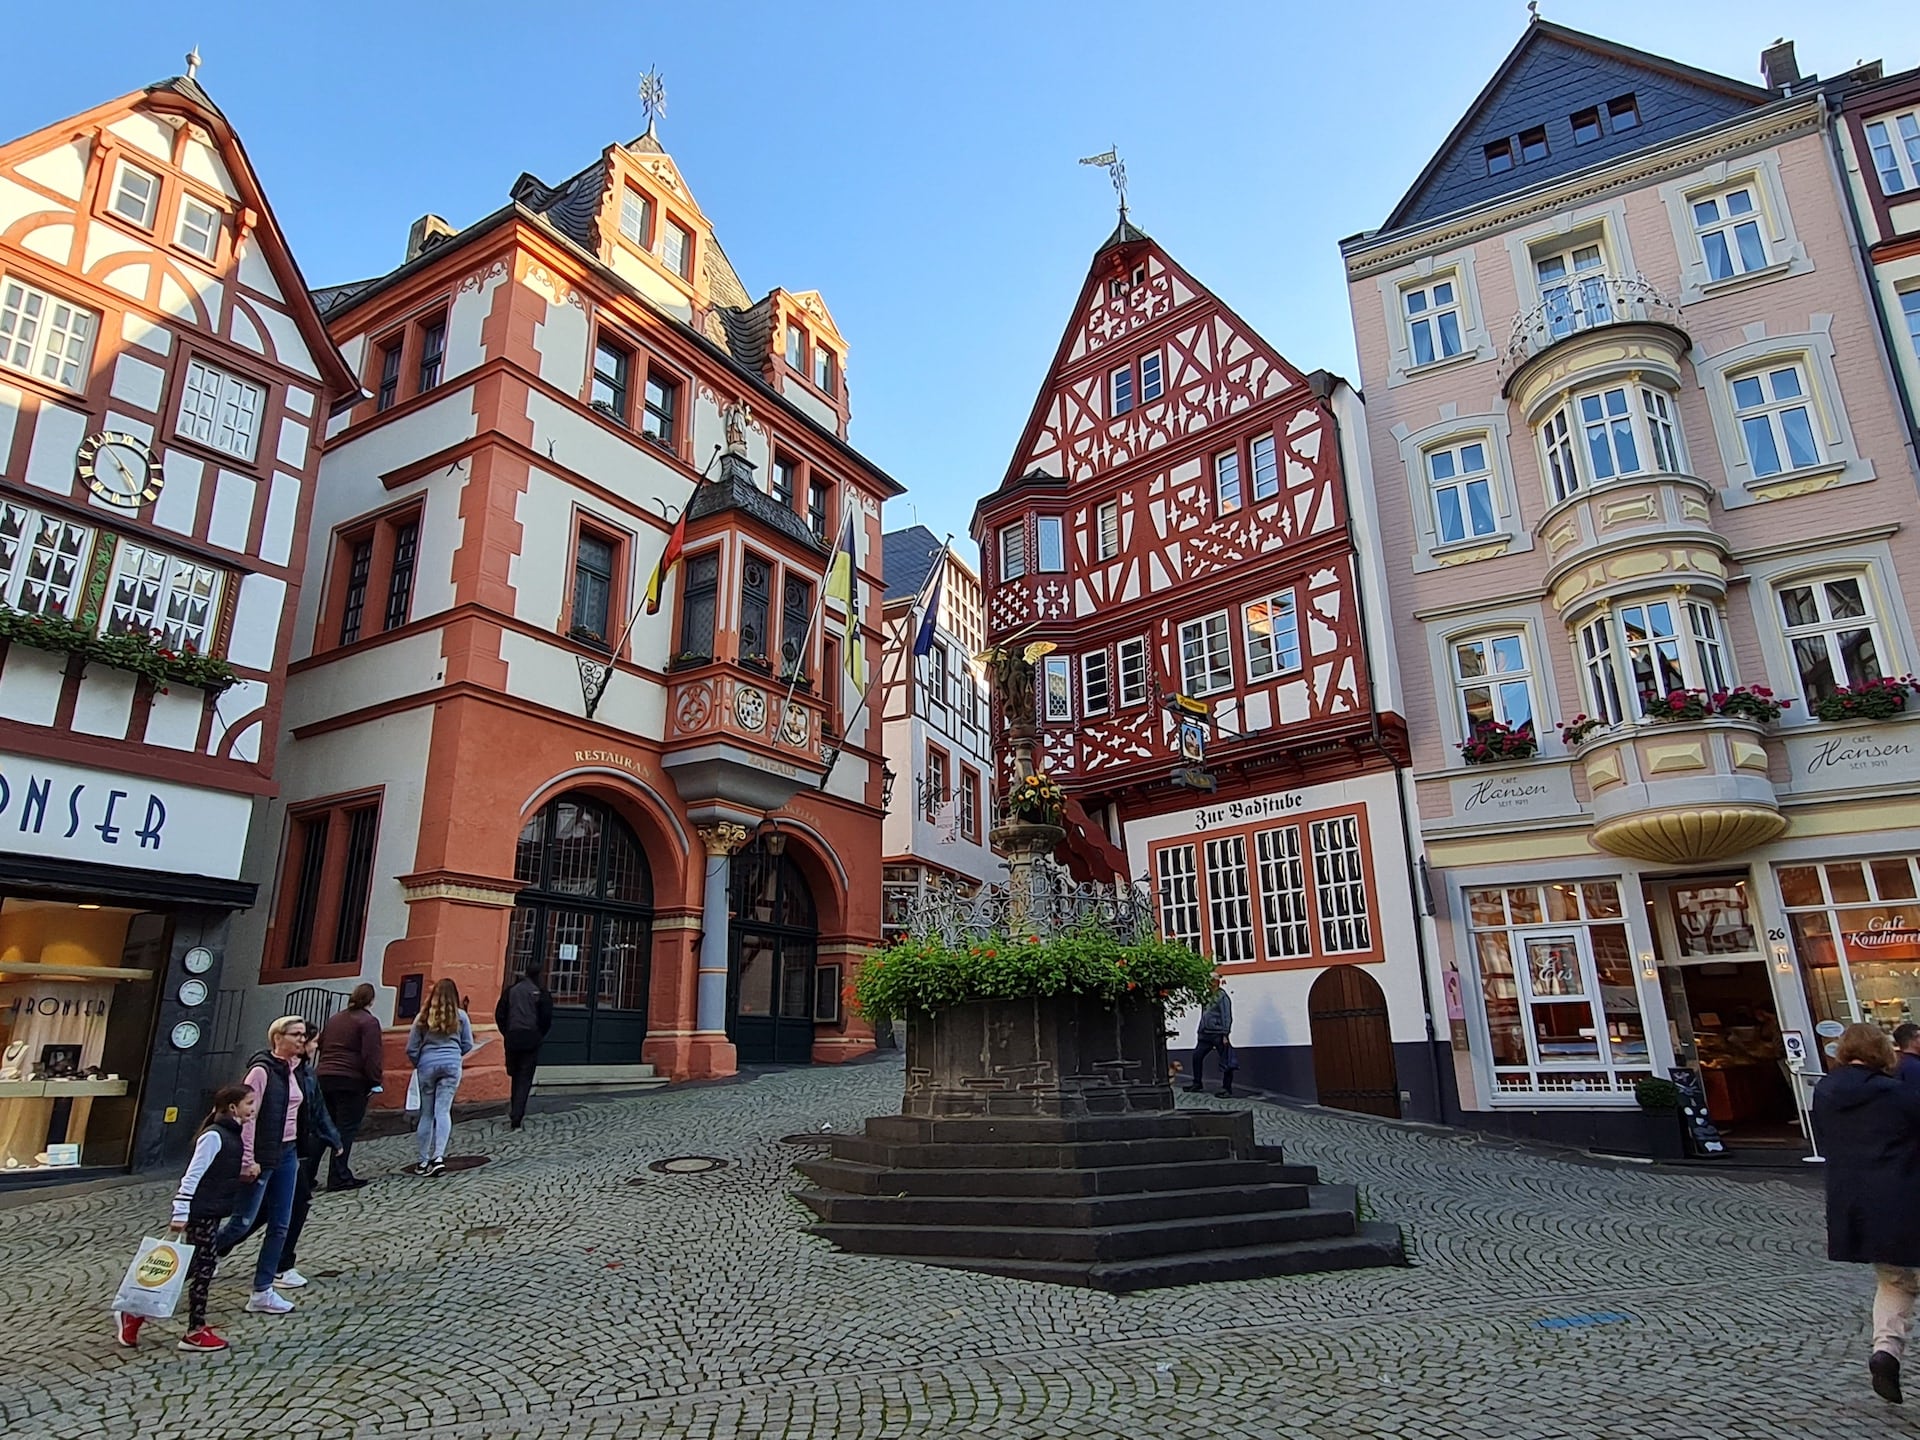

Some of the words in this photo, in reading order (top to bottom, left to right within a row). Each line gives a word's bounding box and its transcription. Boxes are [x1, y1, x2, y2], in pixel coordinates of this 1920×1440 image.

[574, 750, 654, 781] RESTAURAN
[1808, 738, 1912, 774] Hansen
[1464, 779, 1548, 811] Hansen
[0, 773, 166, 850] NSER
[1195, 810, 1225, 830] Zur
[1767, 928, 1785, 940] 26
[1536, 957, 1573, 981] Eis
